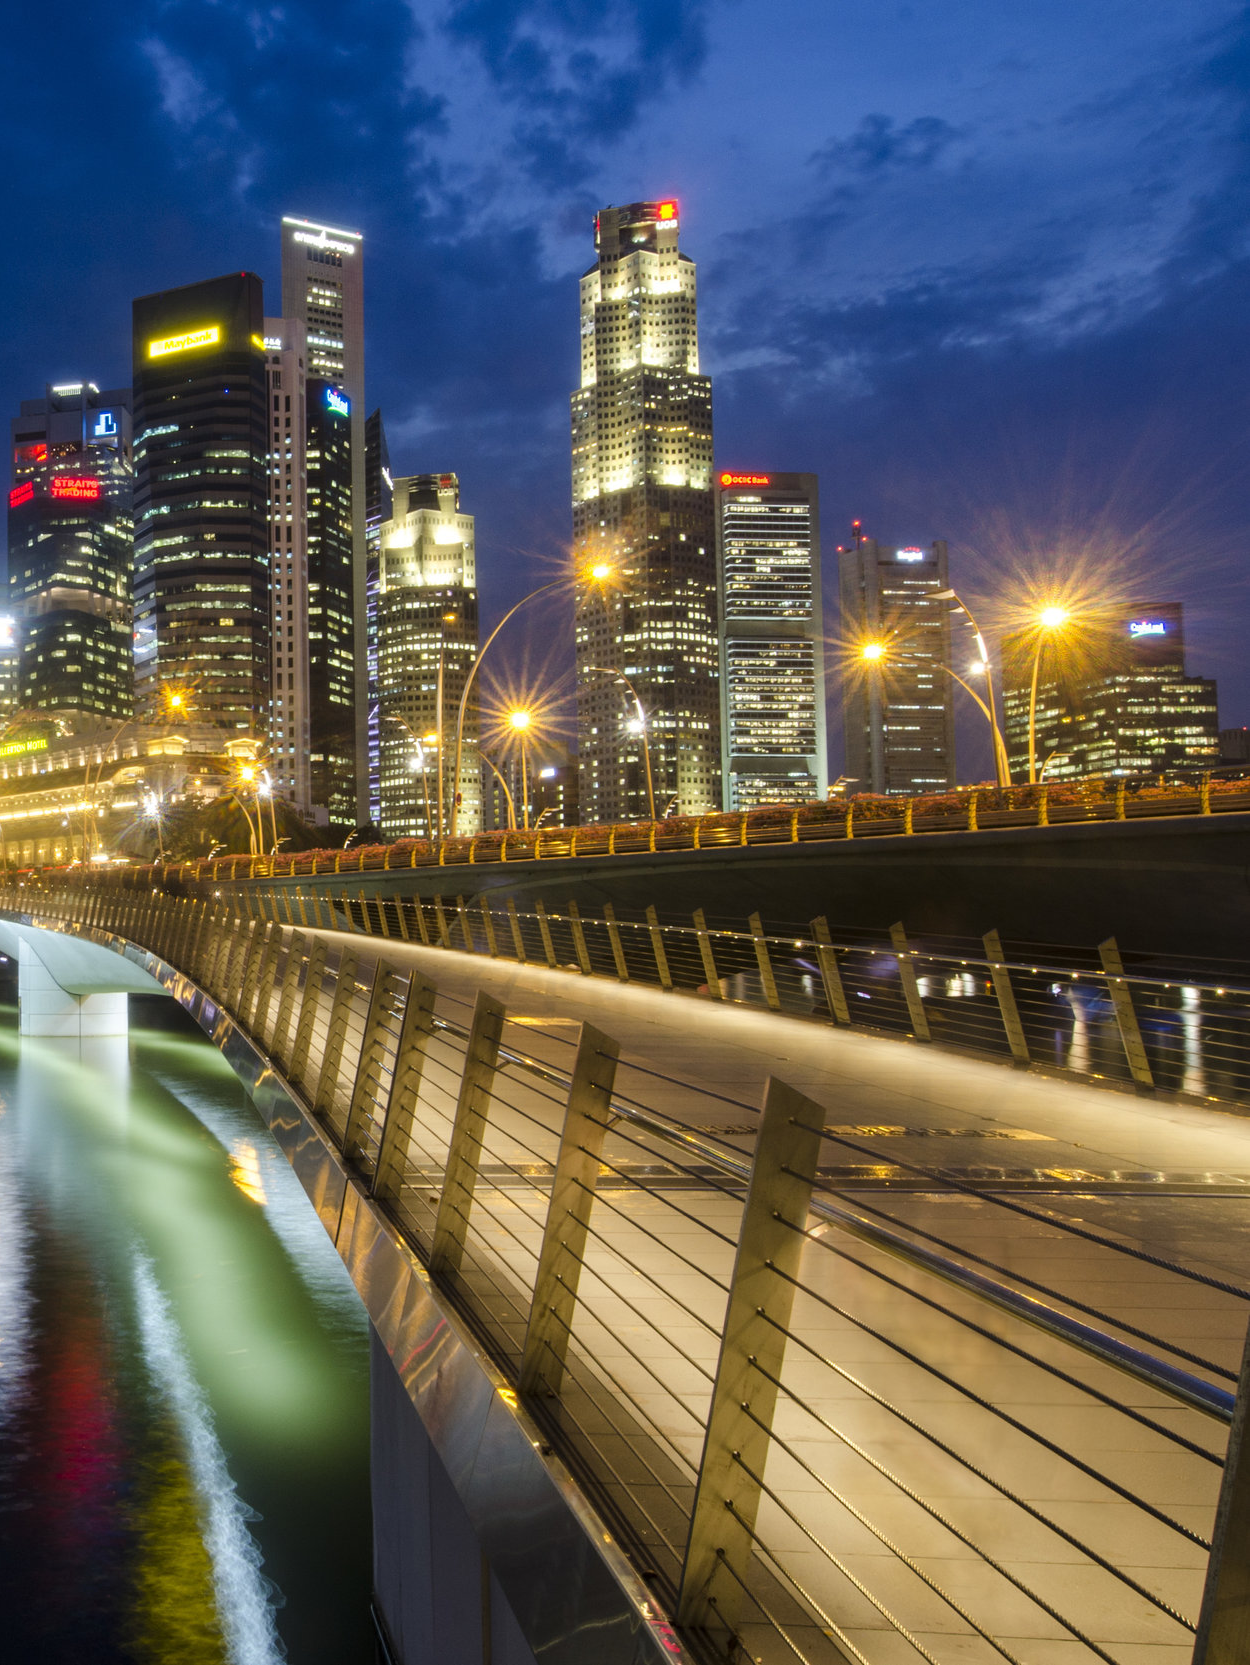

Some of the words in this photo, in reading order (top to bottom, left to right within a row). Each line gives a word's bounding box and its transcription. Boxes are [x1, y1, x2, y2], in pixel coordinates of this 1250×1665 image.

[655, 219, 678, 231] UOB
[164, 331, 212, 350] Maybank
[54, 479, 98, 488] STRAITS
[52, 488, 98, 498] TRADING
[438, 488, 454, 497] UOB
[27, 739, 48, 751] HOTEL
